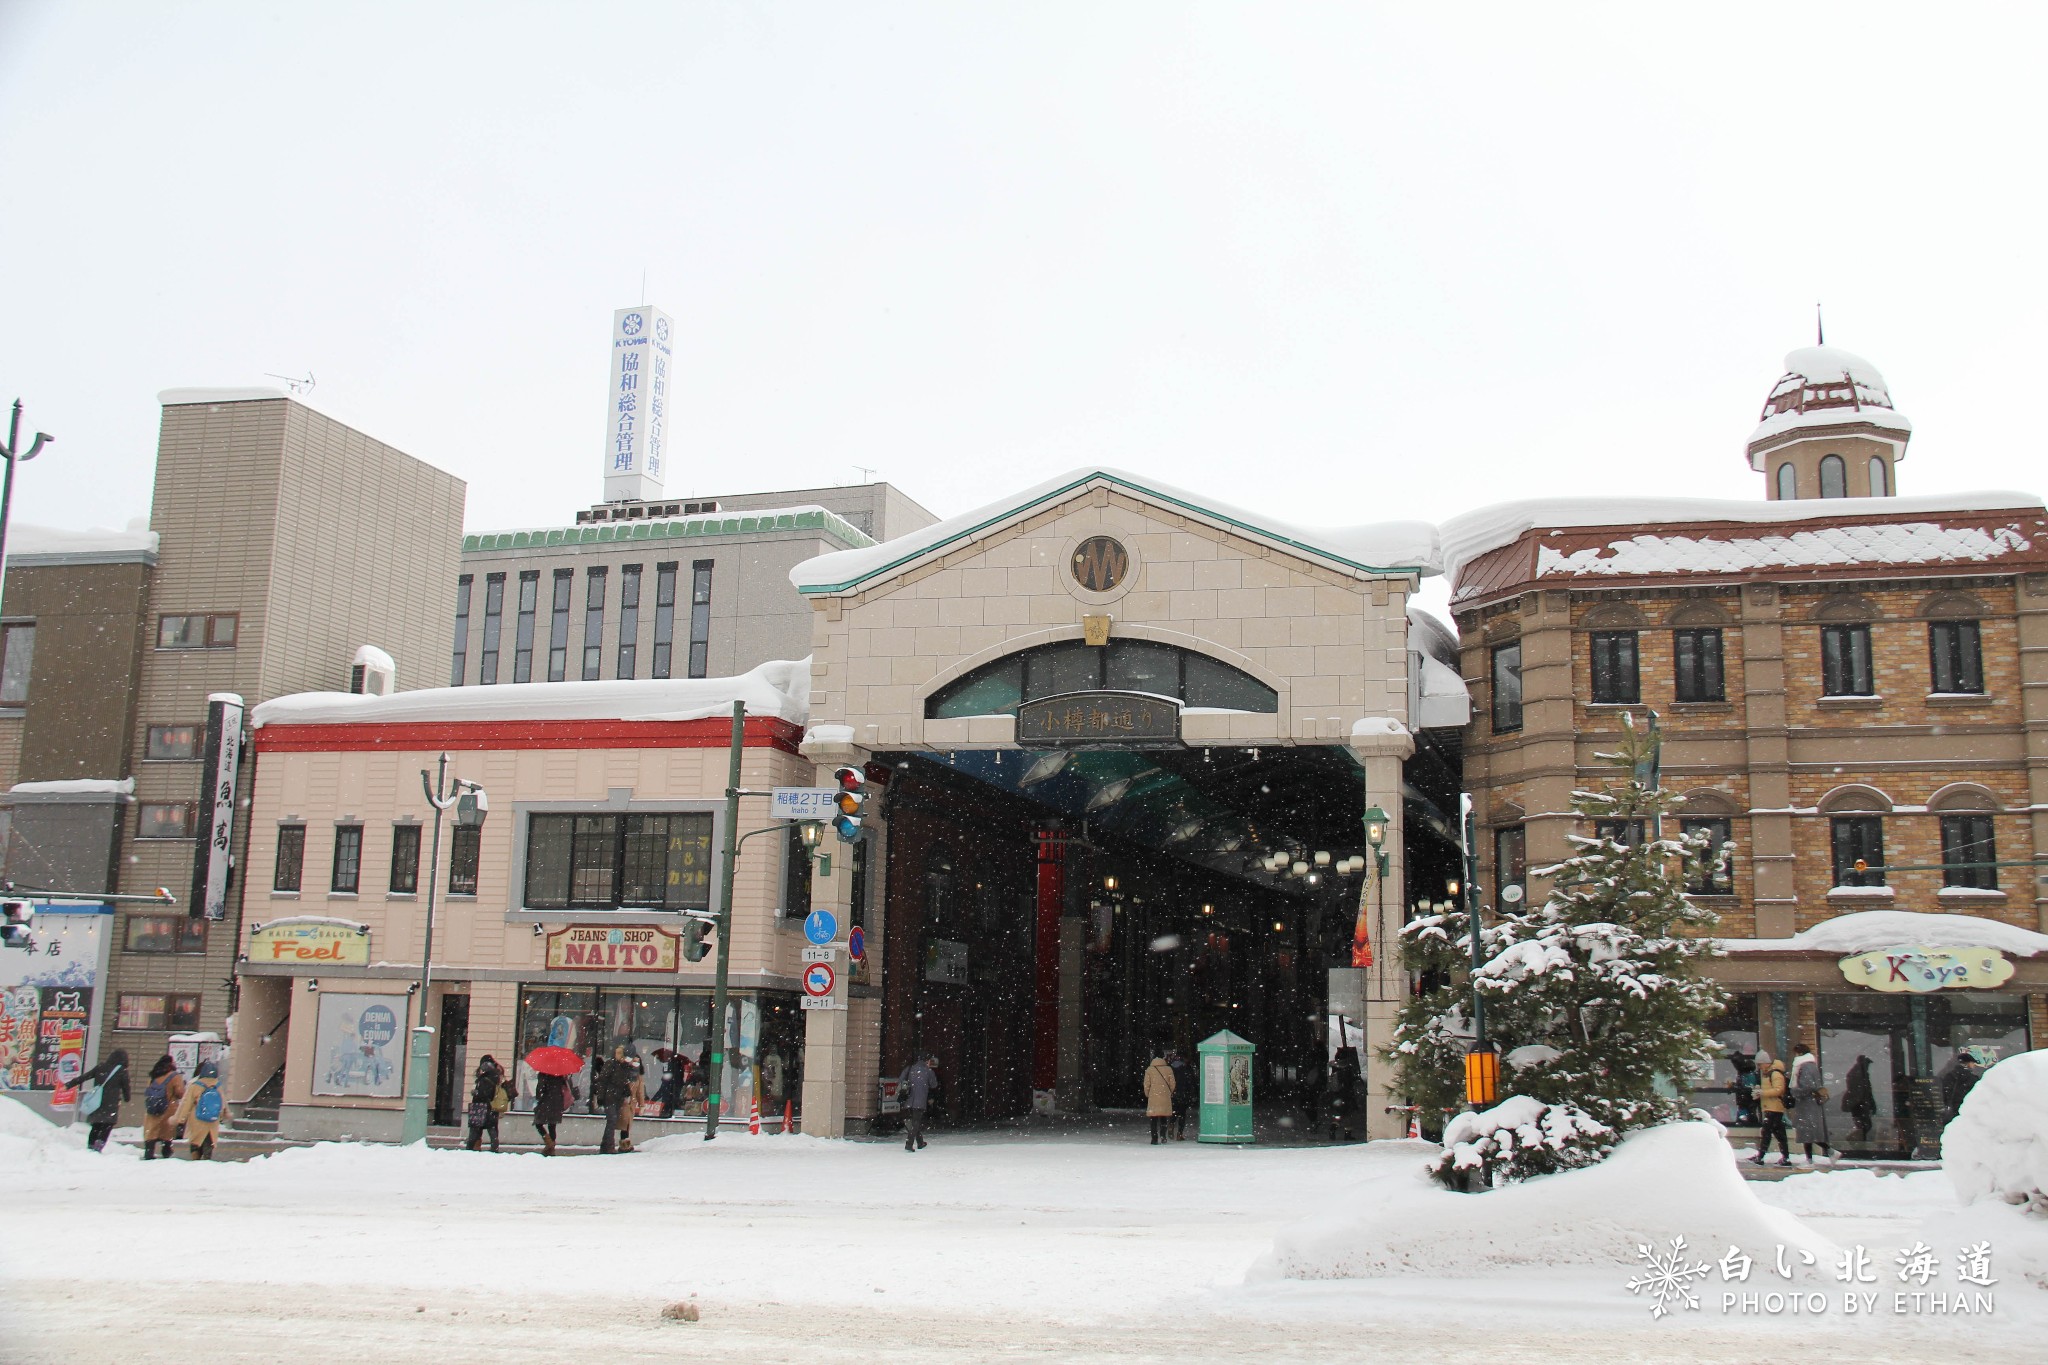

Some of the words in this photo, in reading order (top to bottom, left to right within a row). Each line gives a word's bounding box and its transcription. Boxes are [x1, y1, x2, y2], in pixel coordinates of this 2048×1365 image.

[615, 337, 648, 348] KYOWA
[651, 339, 671, 356] KYOWA
[614, 352, 640, 471] 協和総合管理
[647, 355, 666, 477] 協和総合管理
[1041, 708, 1153, 732] 小樽都通り
[777, 792, 833, 806] 稲穂2丁目
[668, 870, 709, 886] カット
[318, 930, 353, 938] SALON
[570, 930, 607, 942] JEANS
[624, 930, 654, 942] SHOP
[272, 940, 346, 960] Feel
[564, 943, 658, 966] NAITO
[807, 951, 830, 960] 11-8
[806, 998, 829, 1007] 8-11
[365, 1011, 391, 1023] DENIM
[363, 1030, 391, 1041] EDWIN
[12, 1019, 36, 1085] 魚と酒
